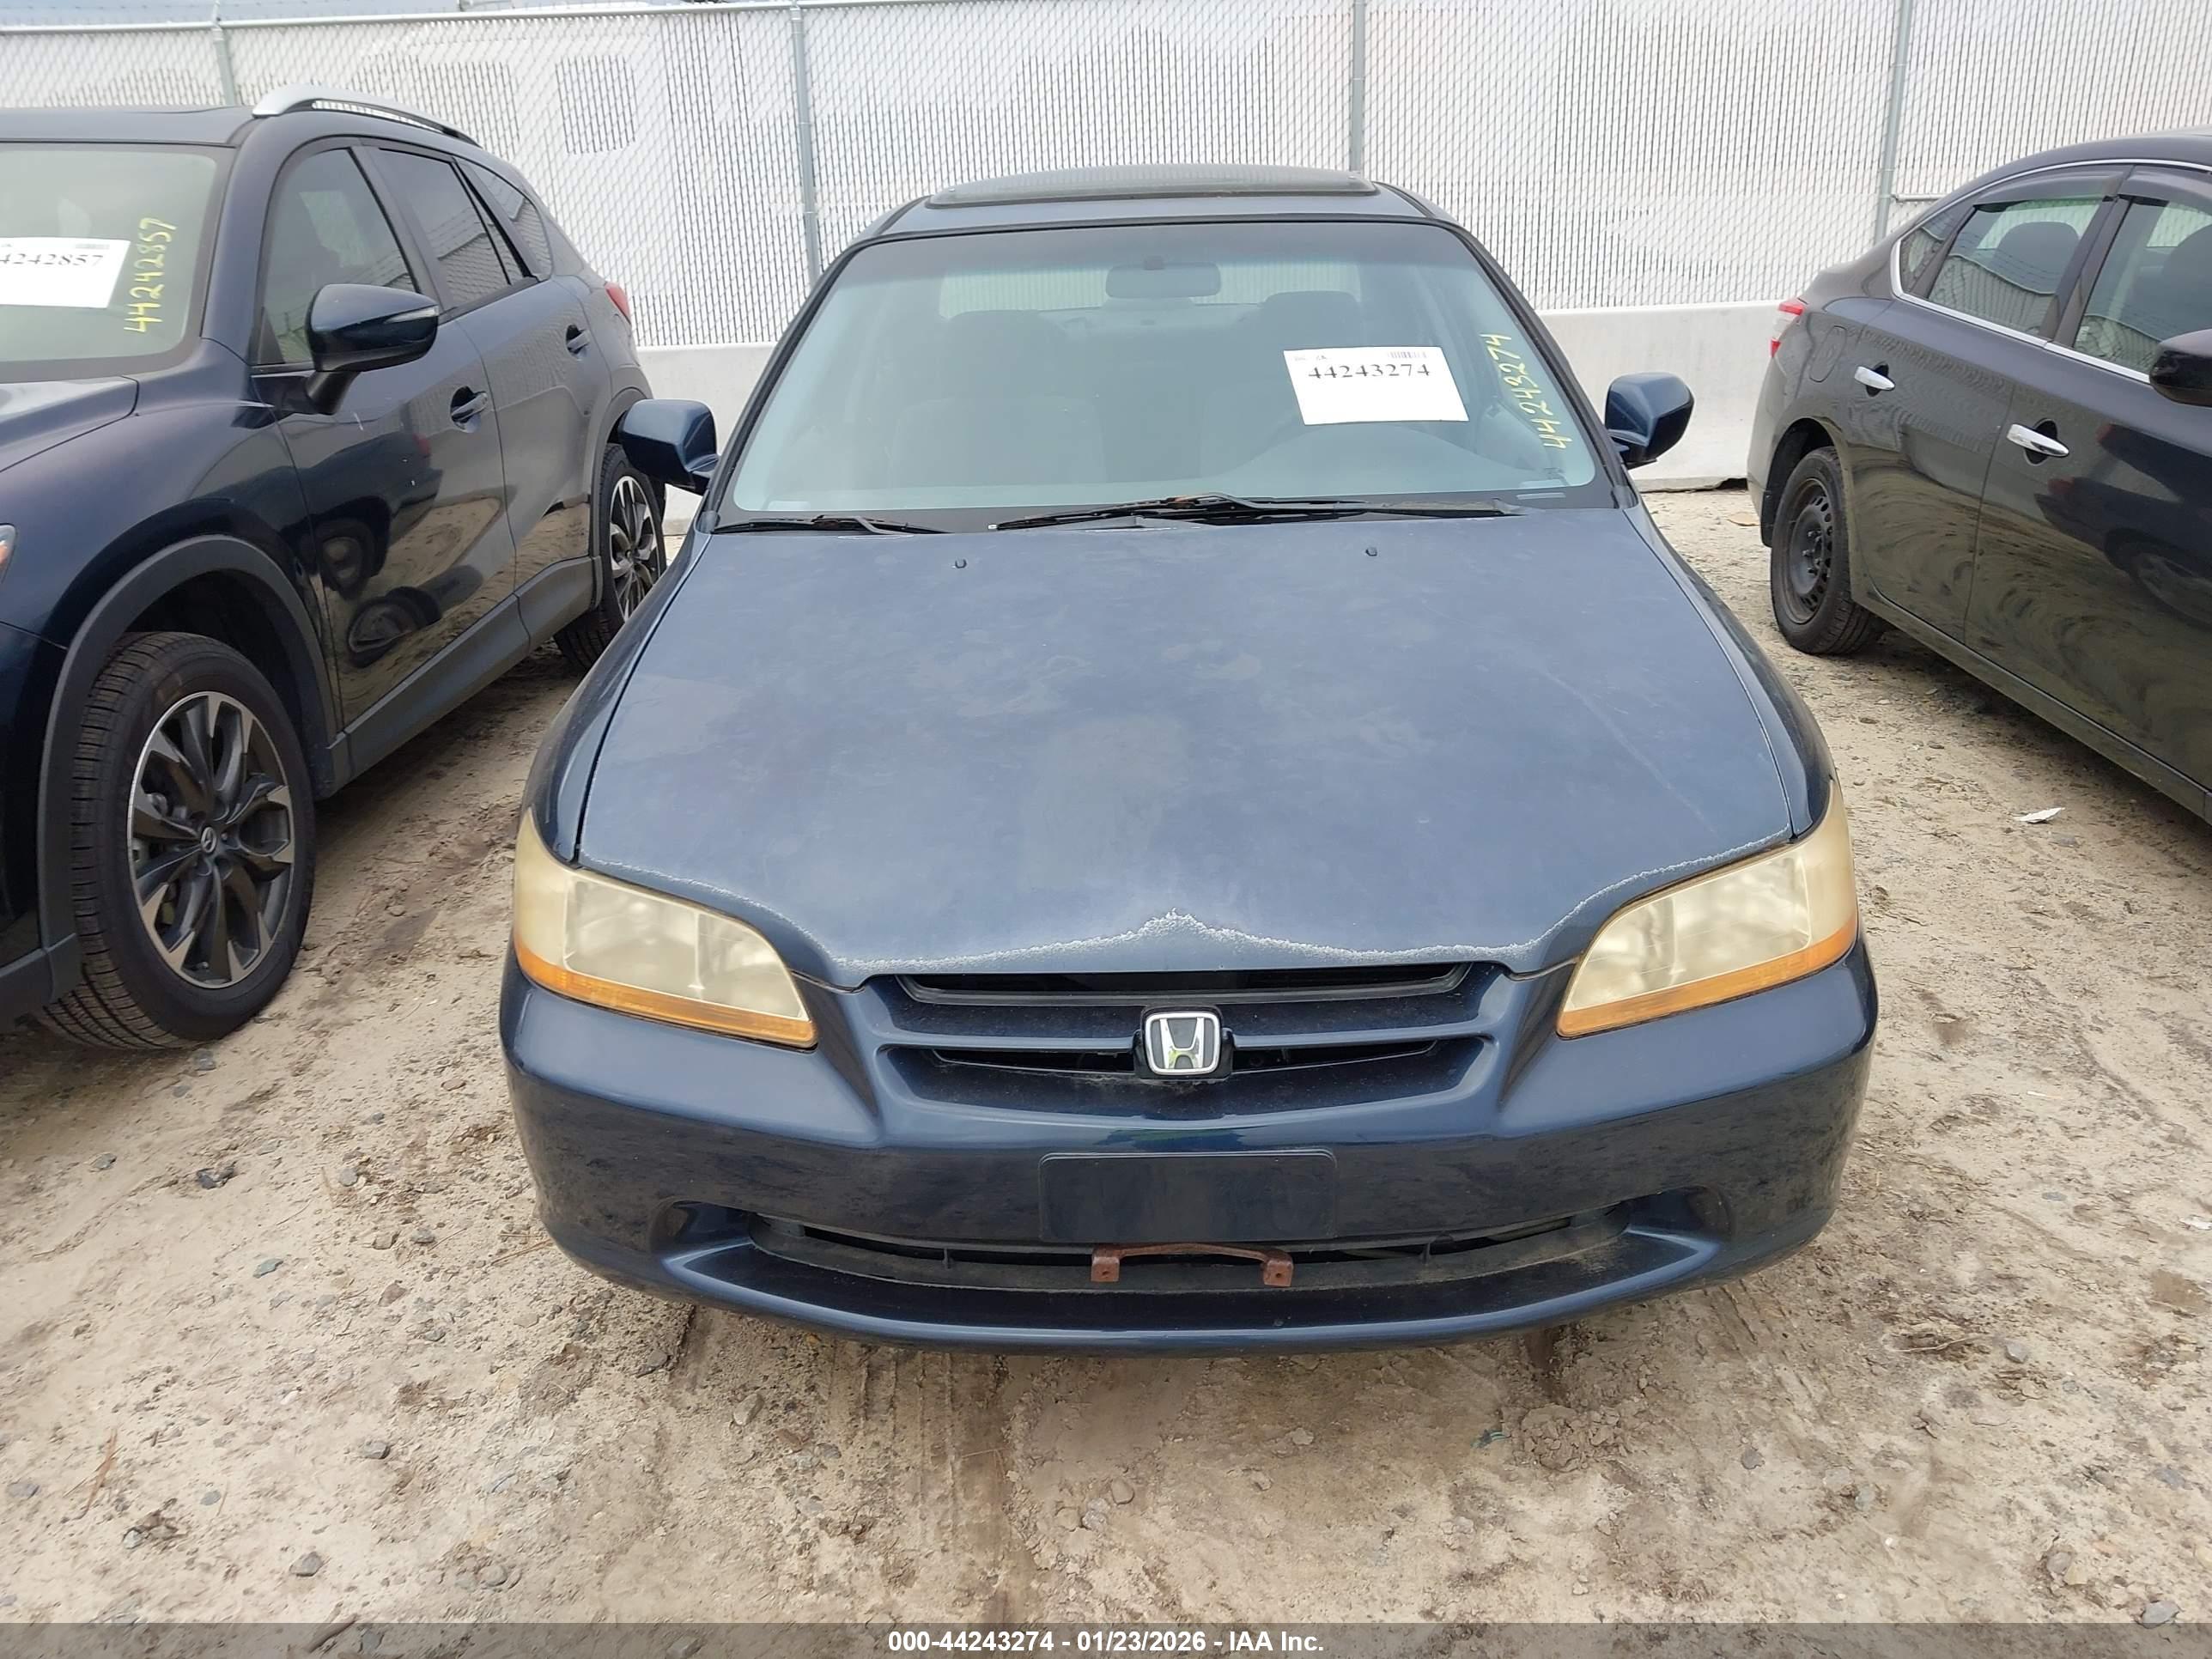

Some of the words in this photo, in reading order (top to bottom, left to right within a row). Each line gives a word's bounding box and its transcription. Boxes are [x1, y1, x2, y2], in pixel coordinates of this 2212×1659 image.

[123, 217, 178, 333] 44242857
[1308, 363, 1431, 380] 44243274
[1480, 332, 1573, 450] 44243274
